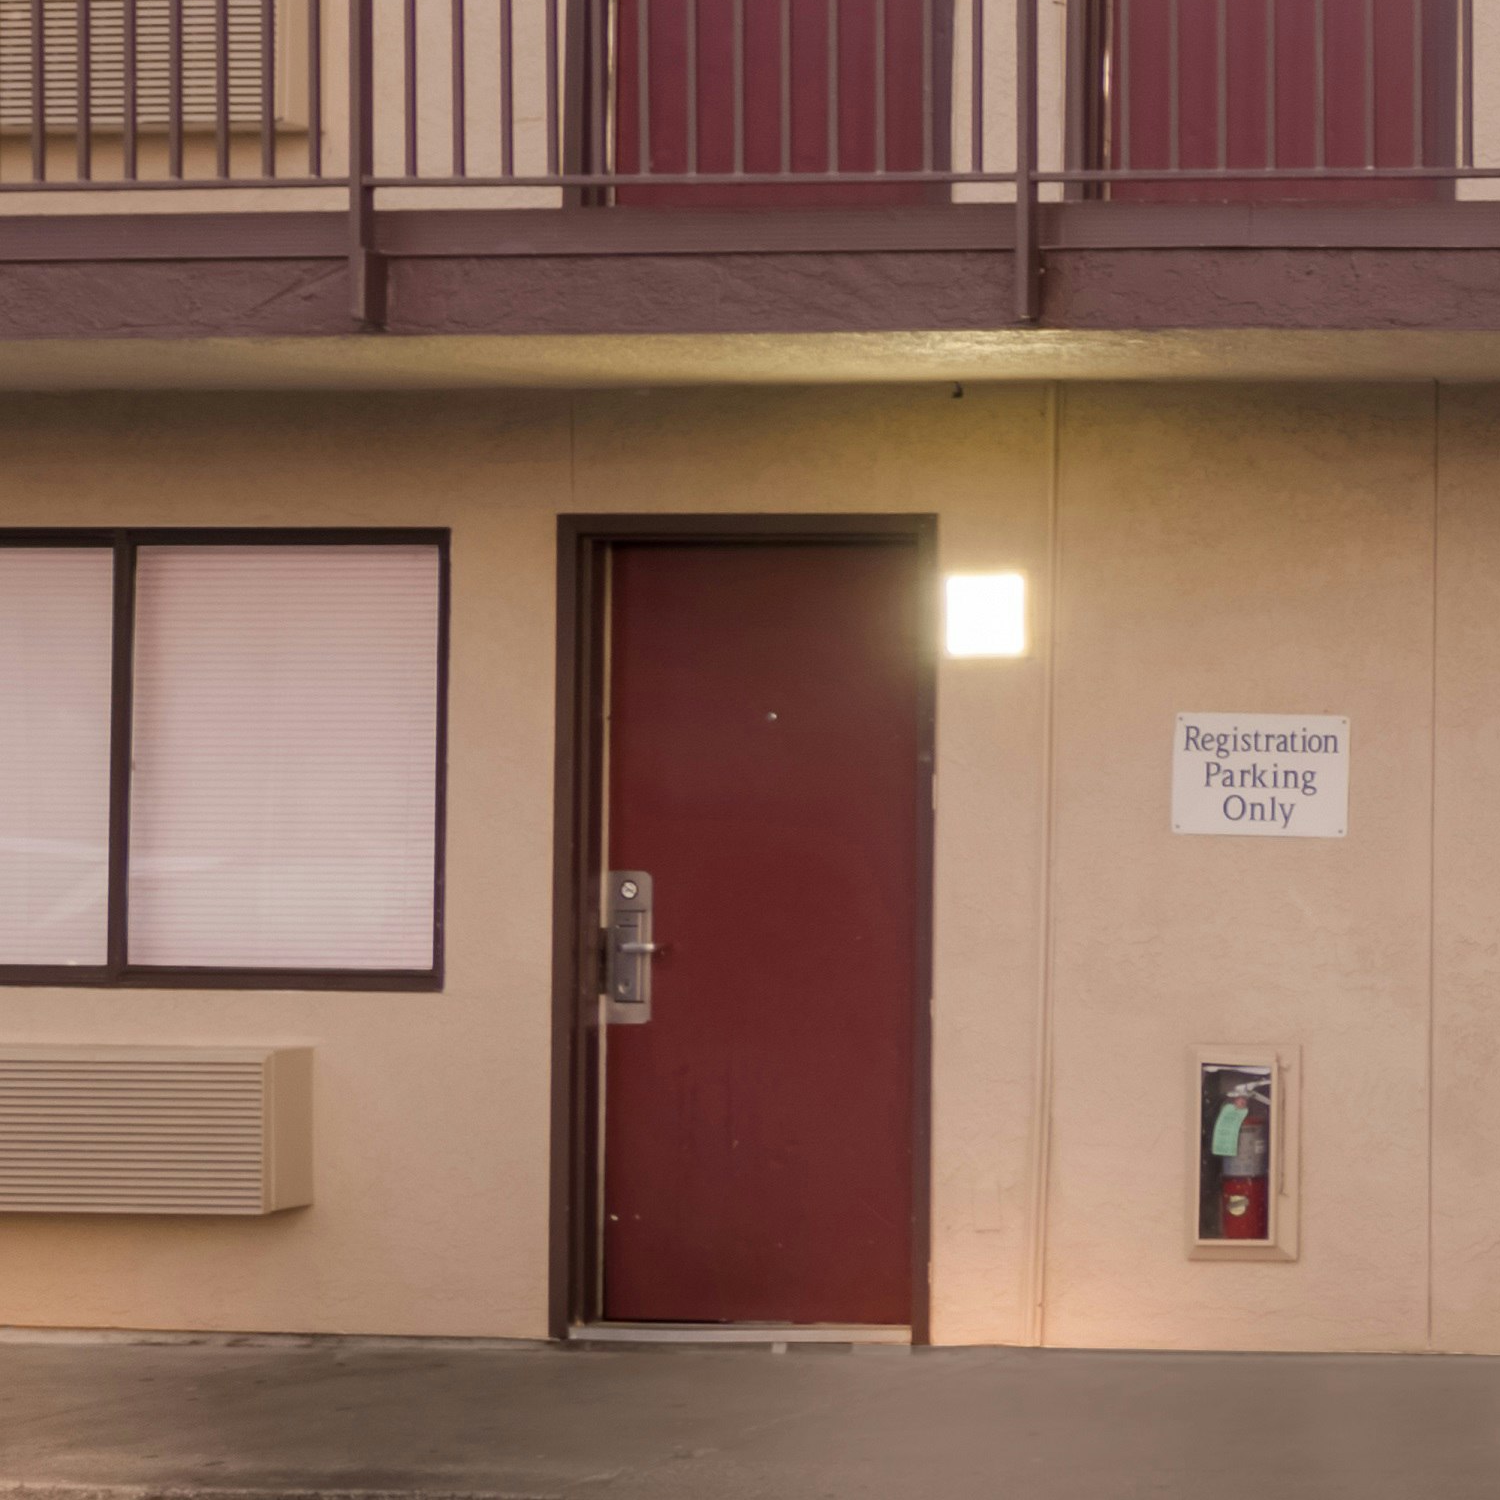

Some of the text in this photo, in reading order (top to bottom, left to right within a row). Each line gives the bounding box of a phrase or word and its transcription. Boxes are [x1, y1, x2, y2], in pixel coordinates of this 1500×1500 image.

[1183, 725, 1340, 759] Registration
[1204, 761, 1318, 796] Parking
[1222, 794, 1296, 829] Only
